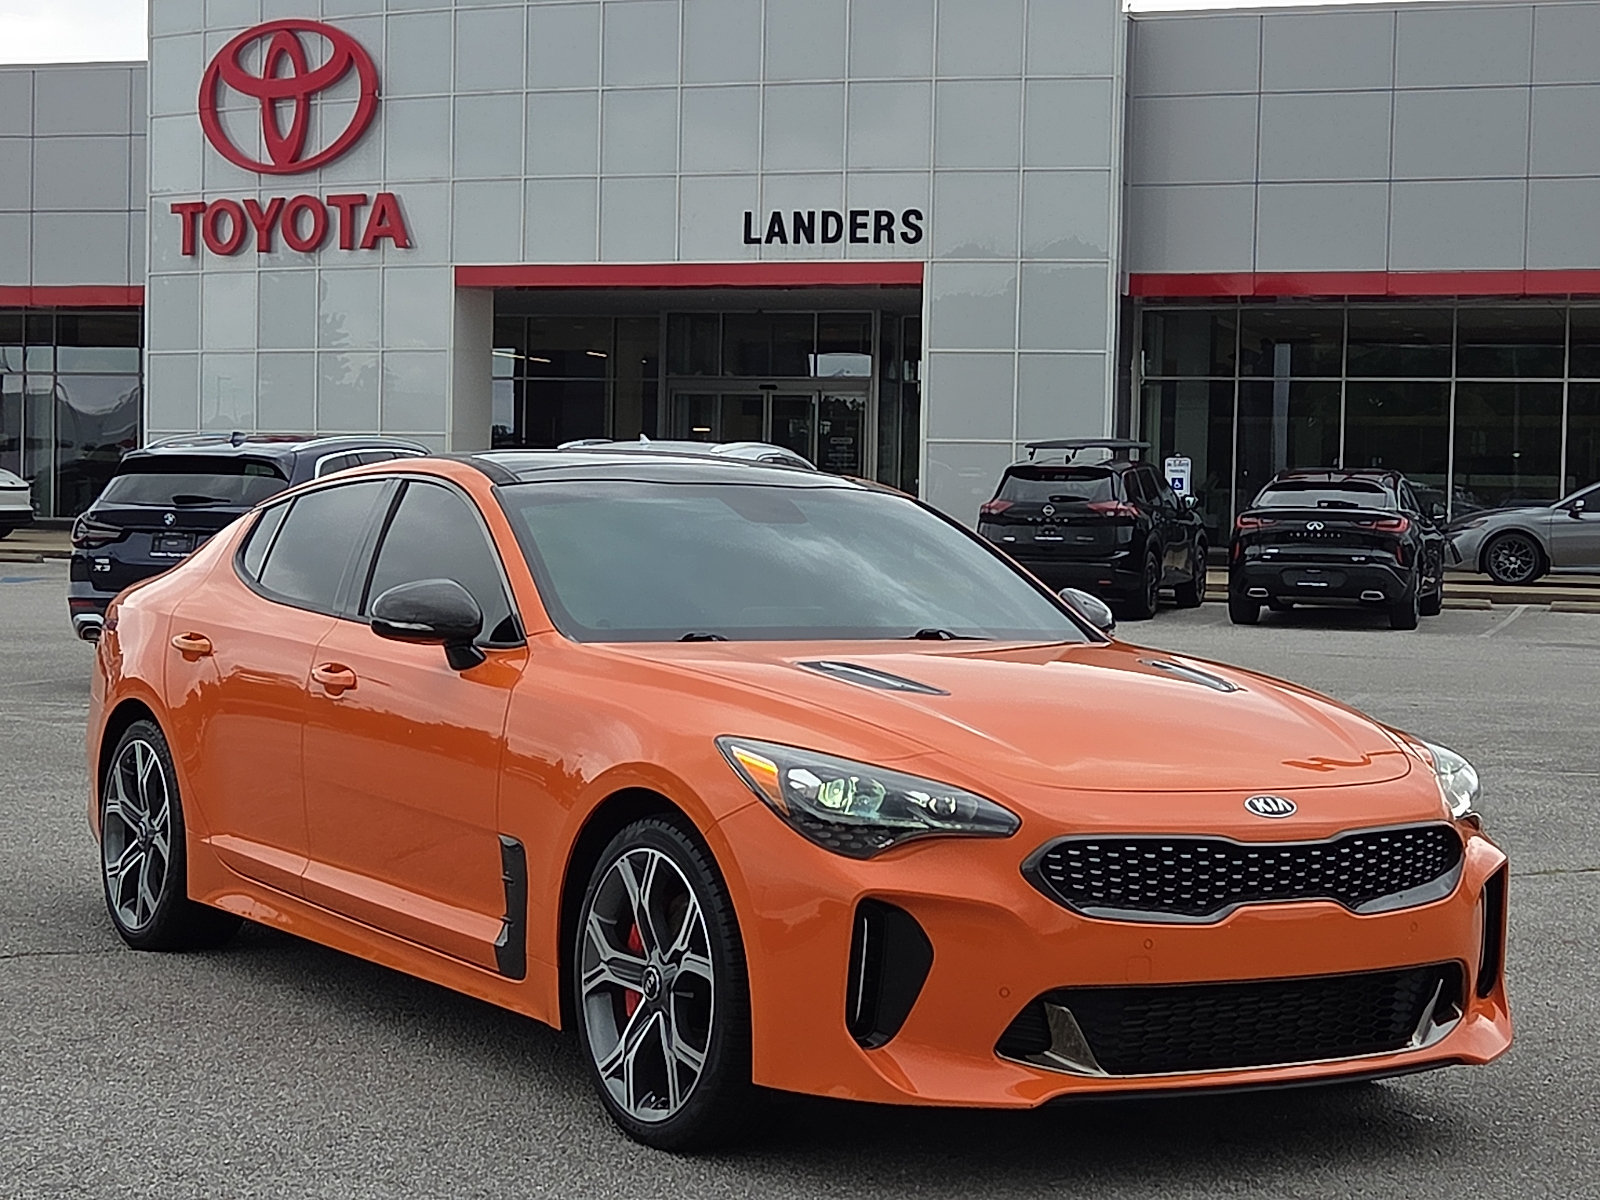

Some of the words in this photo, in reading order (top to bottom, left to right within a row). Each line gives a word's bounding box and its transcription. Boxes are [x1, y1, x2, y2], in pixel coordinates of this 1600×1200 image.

[170, 192, 413, 256] TOYOTA
[743, 208, 924, 244] LANDERS
[1250, 797, 1293, 813] KIA
